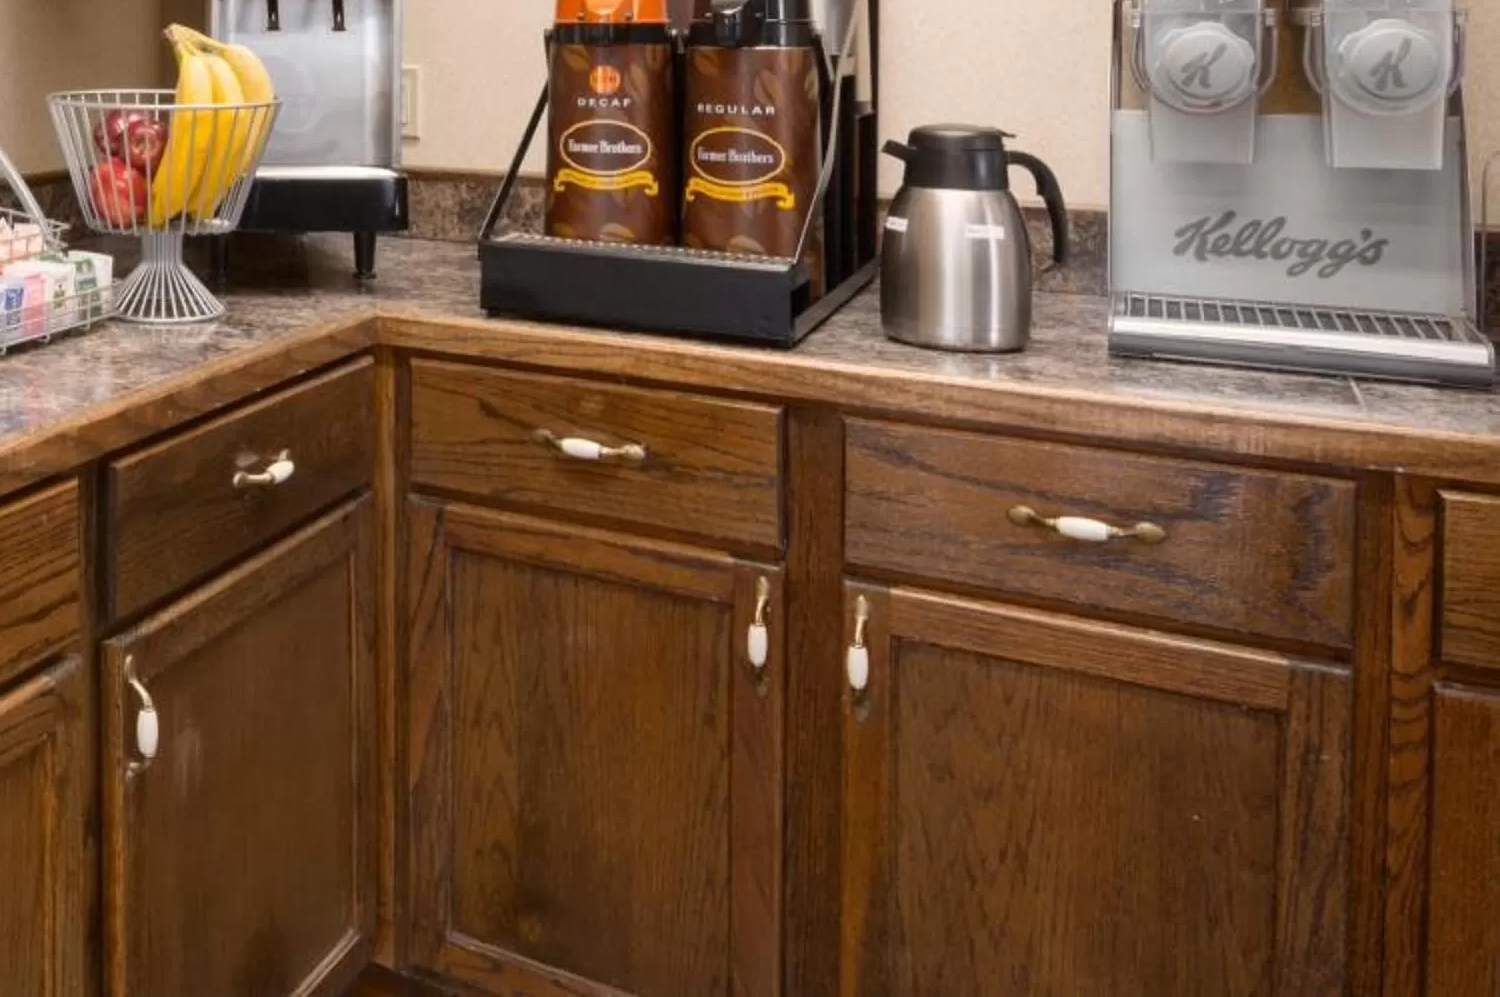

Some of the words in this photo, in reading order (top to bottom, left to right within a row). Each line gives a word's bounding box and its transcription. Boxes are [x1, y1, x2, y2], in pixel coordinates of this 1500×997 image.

[576, 96, 632, 108] DECAF
[697, 103, 776, 116] REGULAR
[1171, 209, 1390, 280] Kellogg's
